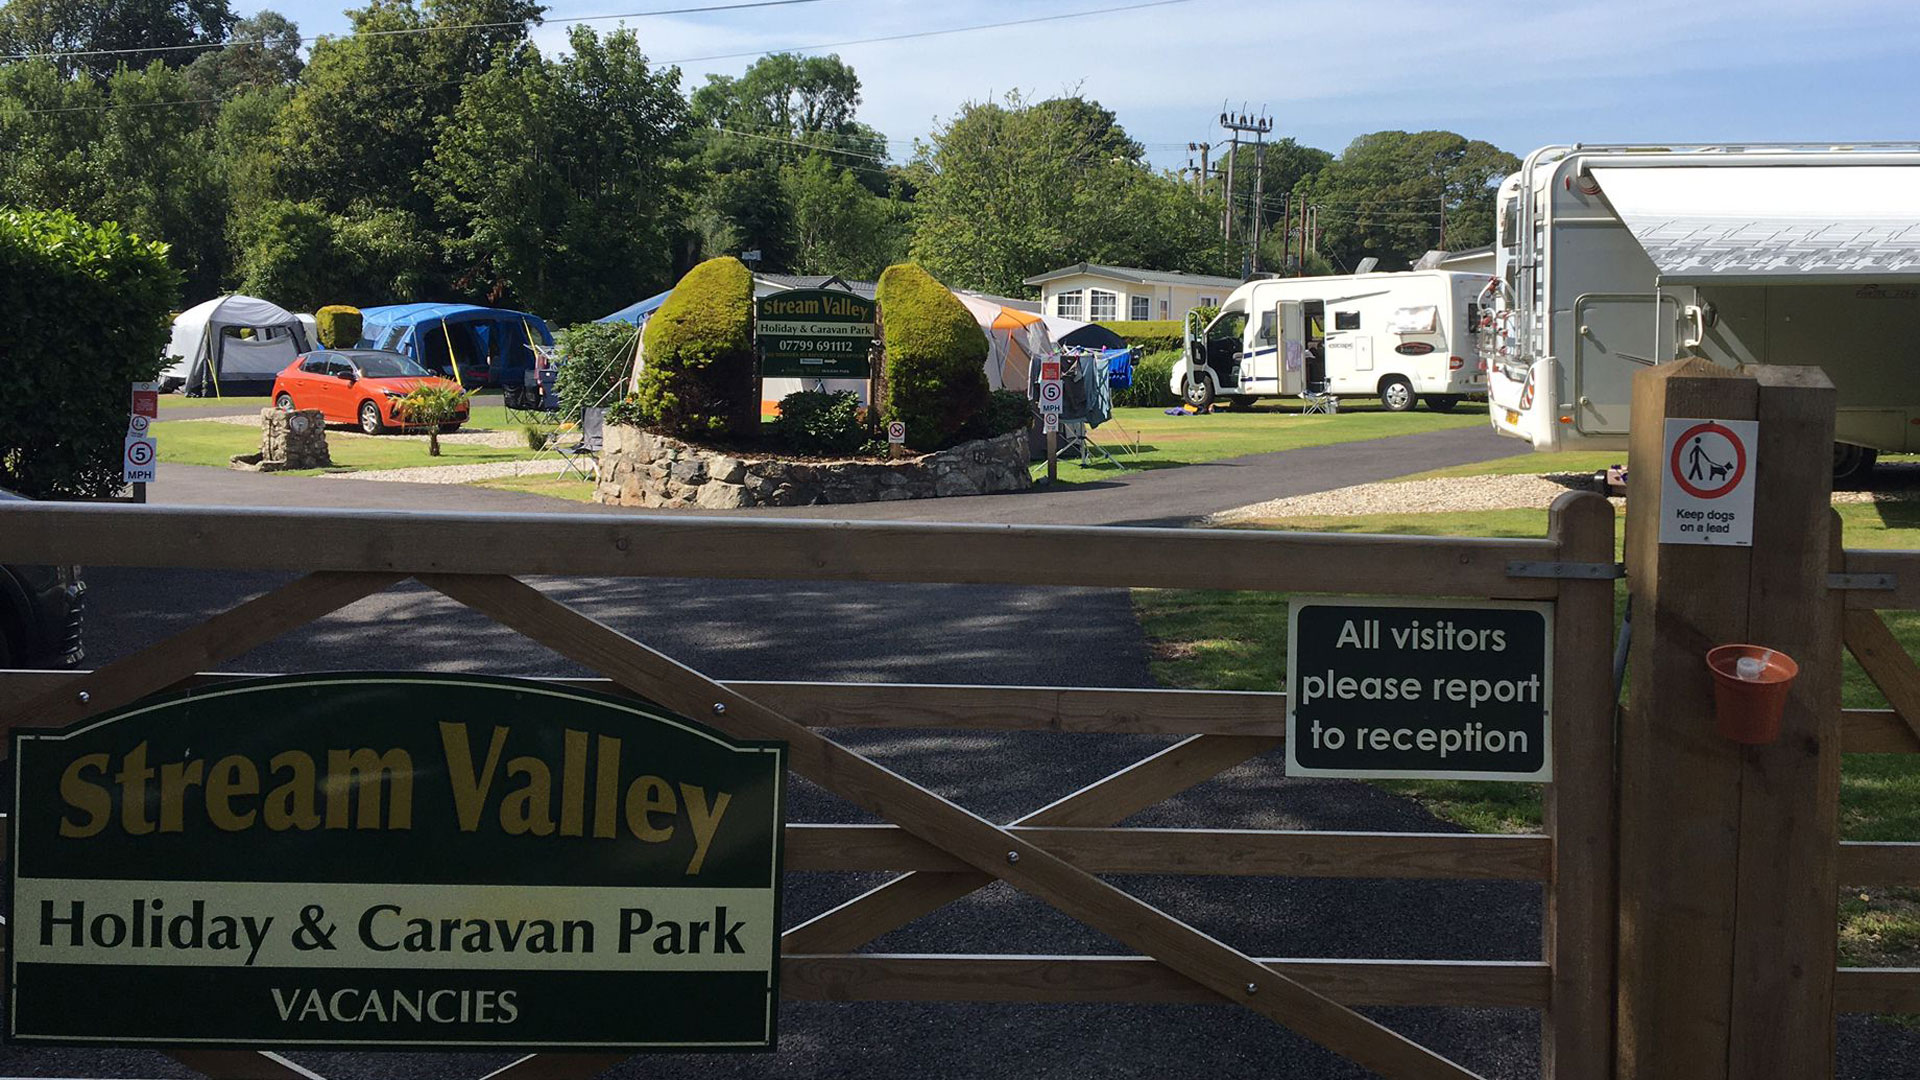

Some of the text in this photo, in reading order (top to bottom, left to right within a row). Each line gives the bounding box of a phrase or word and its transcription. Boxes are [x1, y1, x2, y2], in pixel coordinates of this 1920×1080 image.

[763, 297, 868, 320] Stream Valley
[760, 324, 871, 335] Holiday & Caravan Park
[779, 340, 853, 352] 07799 691112
[1048, 387, 1056, 398] 5
[1043, 404, 1060, 412] MPH
[135, 447, 146, 461] 5
[127, 471, 152, 479] MPH
[1676, 509, 1735, 522] Keep dogs
[1680, 524, 1694, 532] on
[1706, 523, 1730, 533] lead
[1336, 619, 1506, 651] All visitors
[1303, 669, 1540, 708] please report
[1311, 719, 1528, 758] to reception
[58, 721, 732, 875] Stream Valley
[39, 898, 746, 966] Holiday & Caravan Park
[271, 988, 519, 1024] VACANCIES
